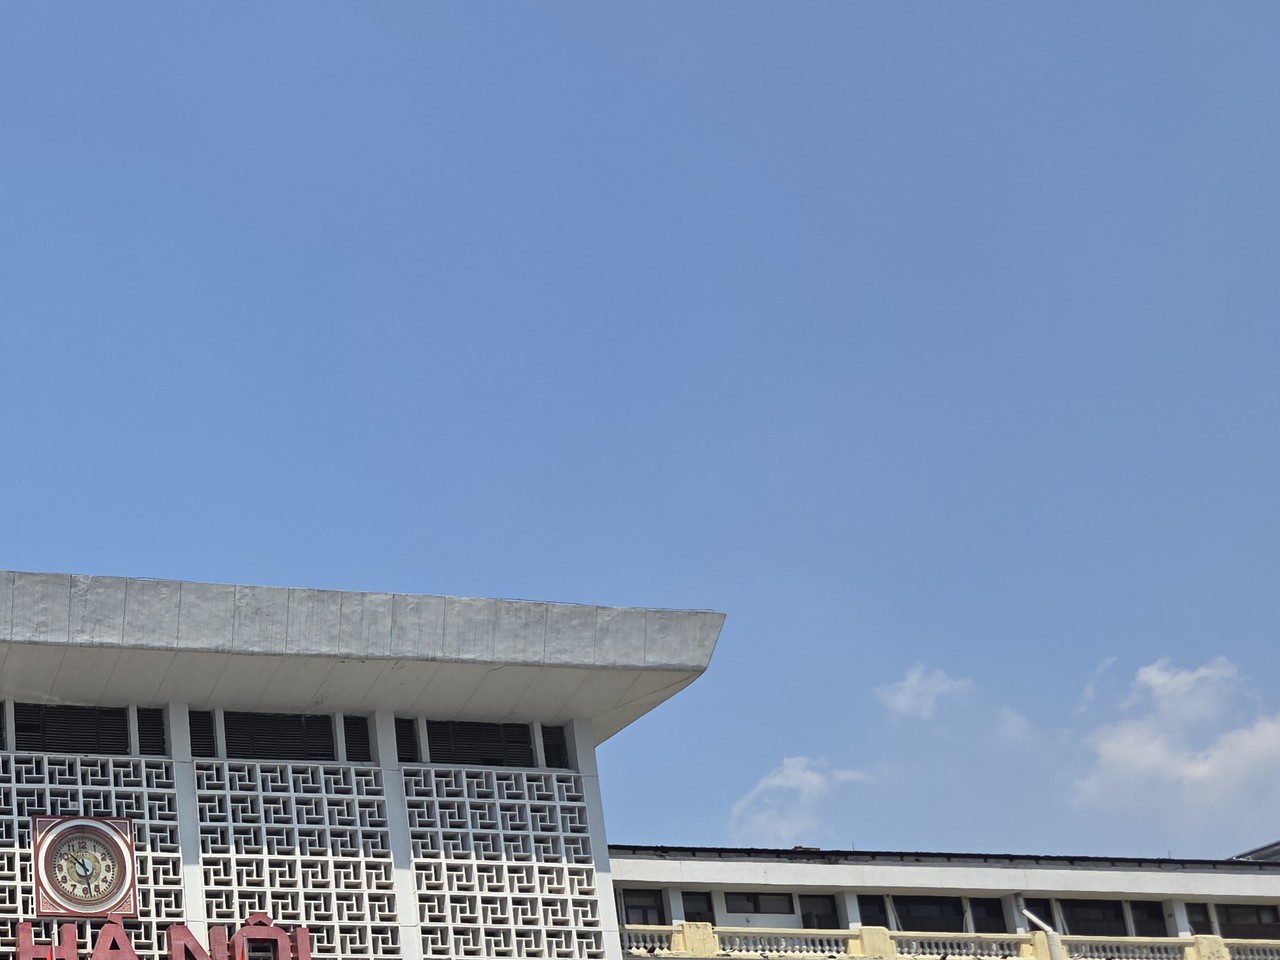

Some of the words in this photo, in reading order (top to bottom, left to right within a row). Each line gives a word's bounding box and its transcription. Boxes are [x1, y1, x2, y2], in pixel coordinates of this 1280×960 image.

[78, 841, 87, 850] 12
[101, 853, 107, 862] 2
[56, 863, 63, 873] 9
[101, 876, 108, 884] 4
[70, 884, 77, 893] 7
[82, 887, 89, 896] 6
